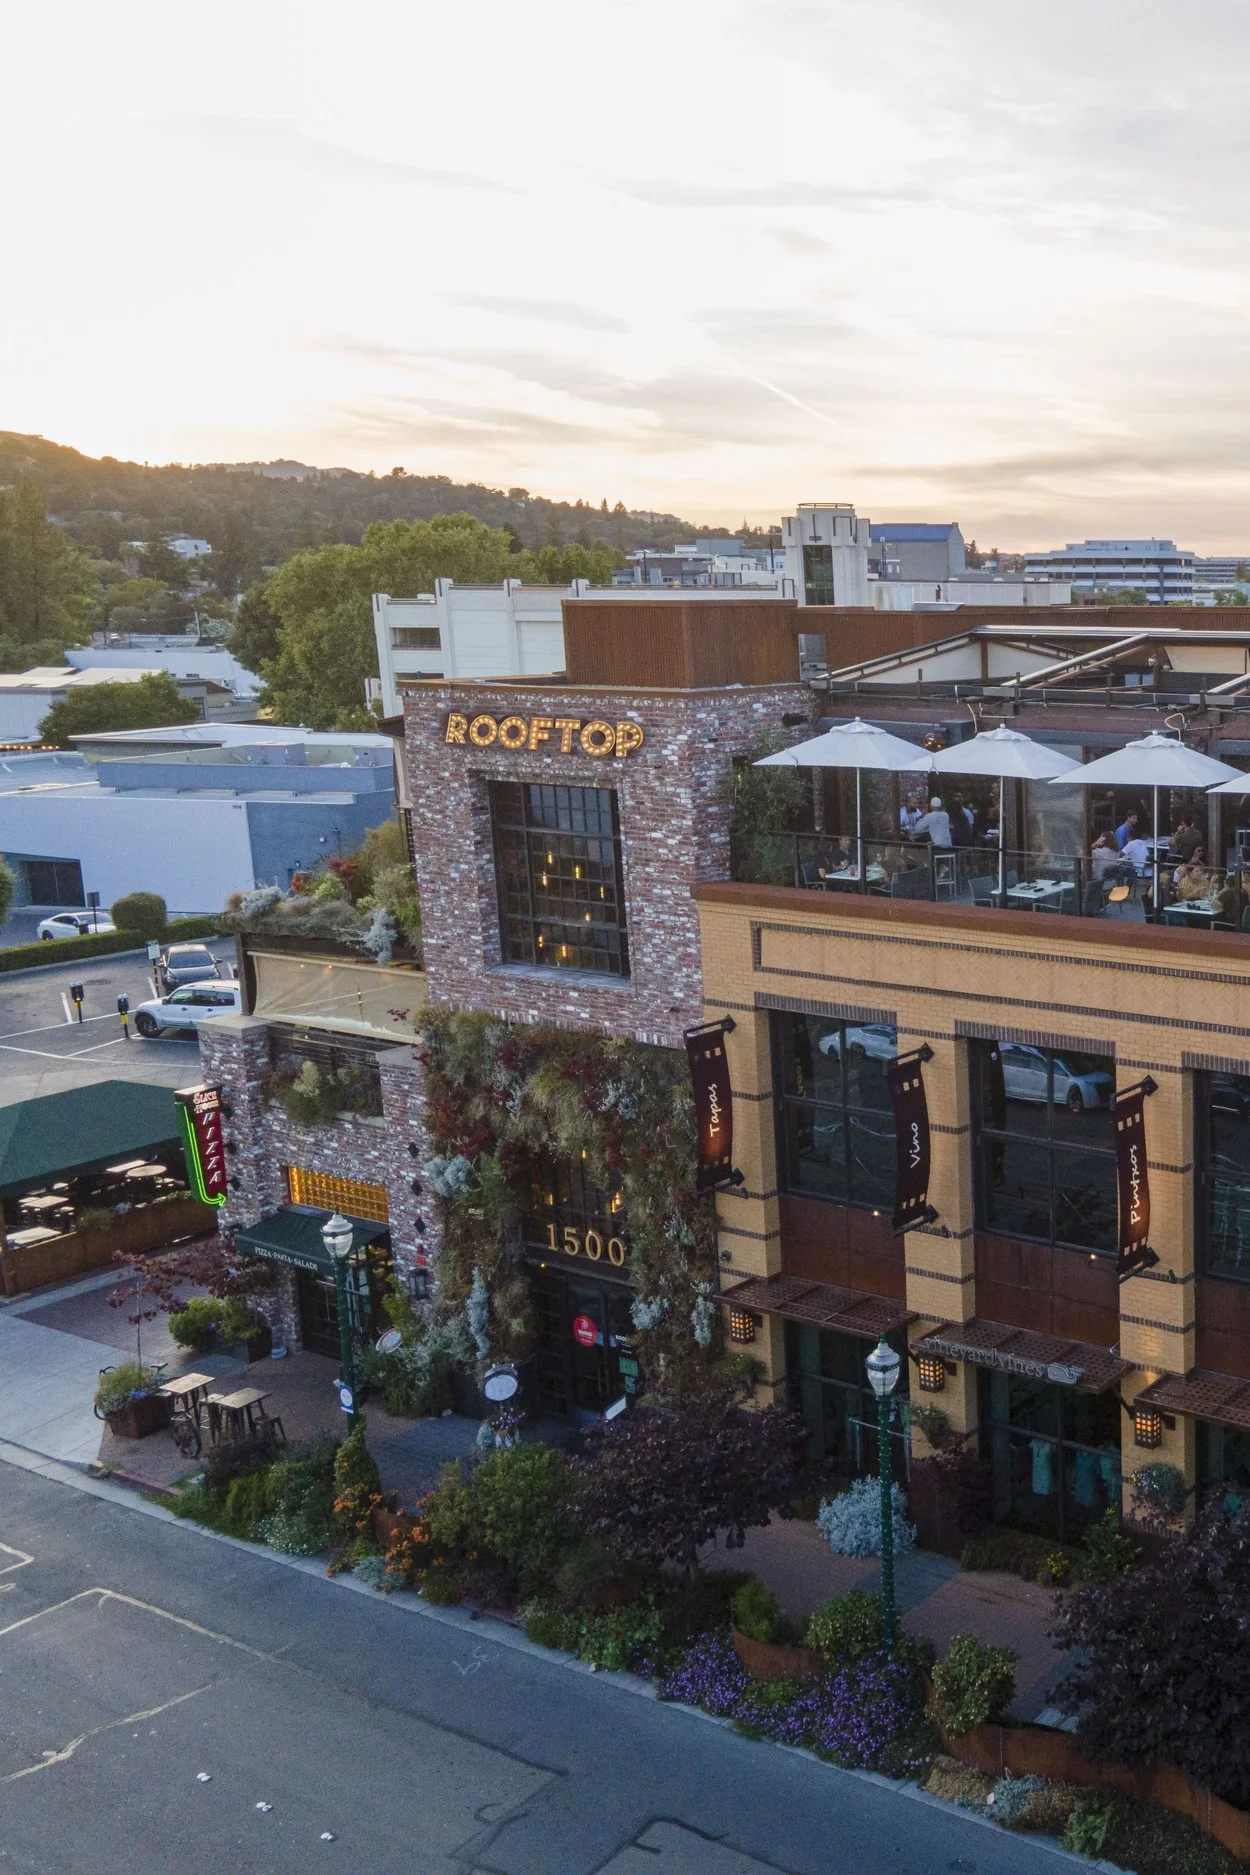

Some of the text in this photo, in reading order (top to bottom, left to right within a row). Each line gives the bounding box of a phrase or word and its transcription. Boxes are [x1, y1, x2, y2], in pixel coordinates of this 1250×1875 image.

[445, 712, 645, 758] ROOFTOP
[707, 1083, 722, 1138] Tapas
[202, 1112, 222, 1184] PIZZA
[908, 1121, 920, 1169] Vino
[1129, 1144, 1141, 1225] Pintxos
[546, 1223, 627, 1267] 1500
[923, 1337, 1044, 1378] vineyard vines
